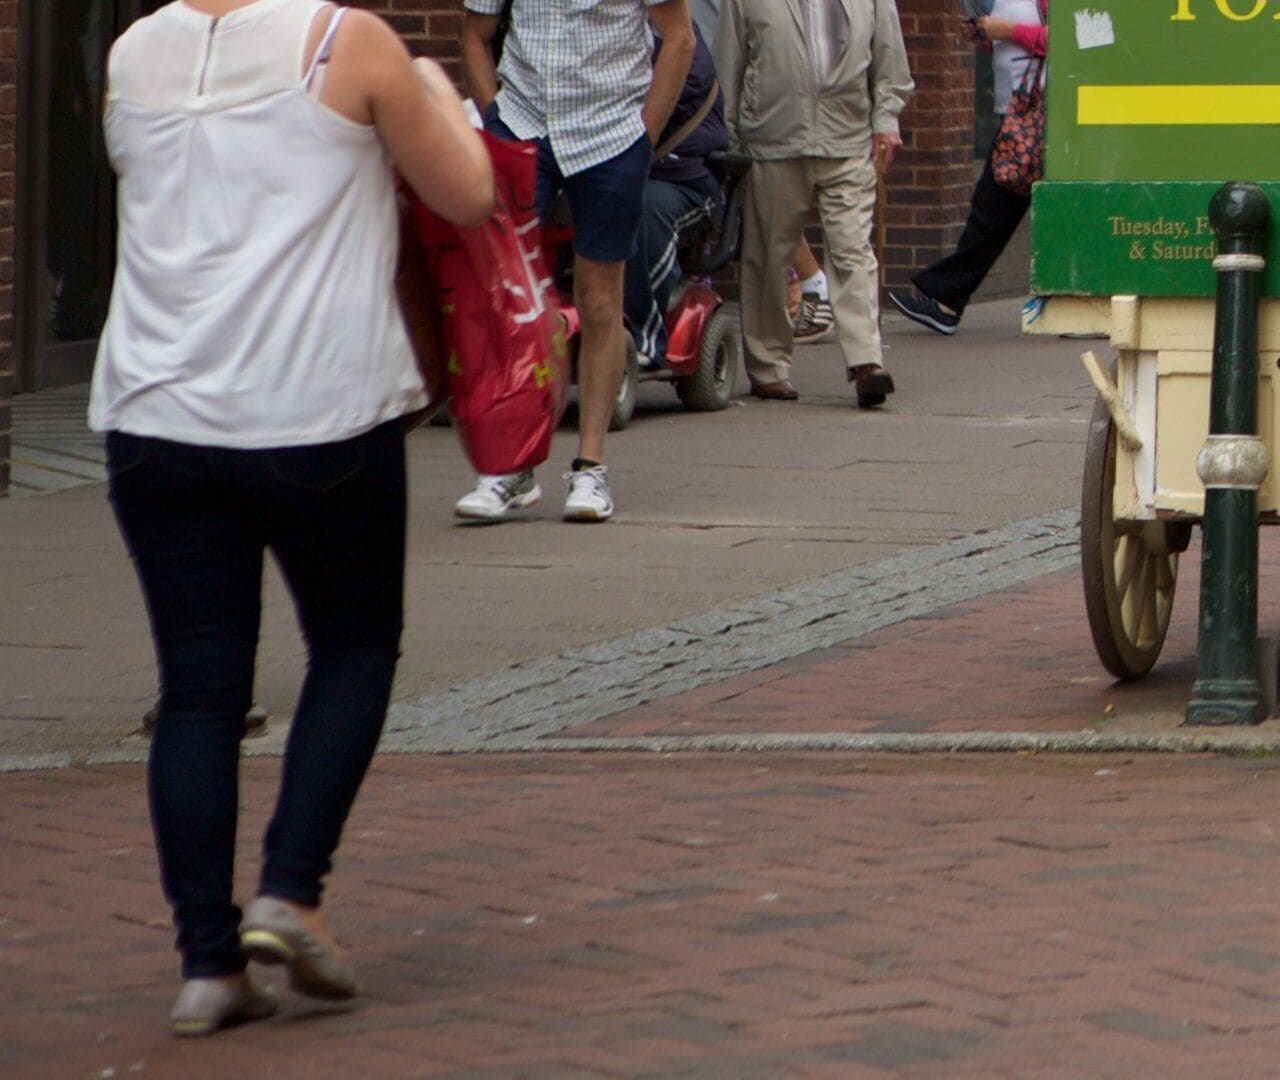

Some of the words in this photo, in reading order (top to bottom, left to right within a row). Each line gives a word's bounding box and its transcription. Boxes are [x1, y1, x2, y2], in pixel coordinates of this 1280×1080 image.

[1108, 217, 1188, 239] Tuesday,
[1129, 240, 1146, 259] &
[1152, 240, 1217, 260] Saturd
